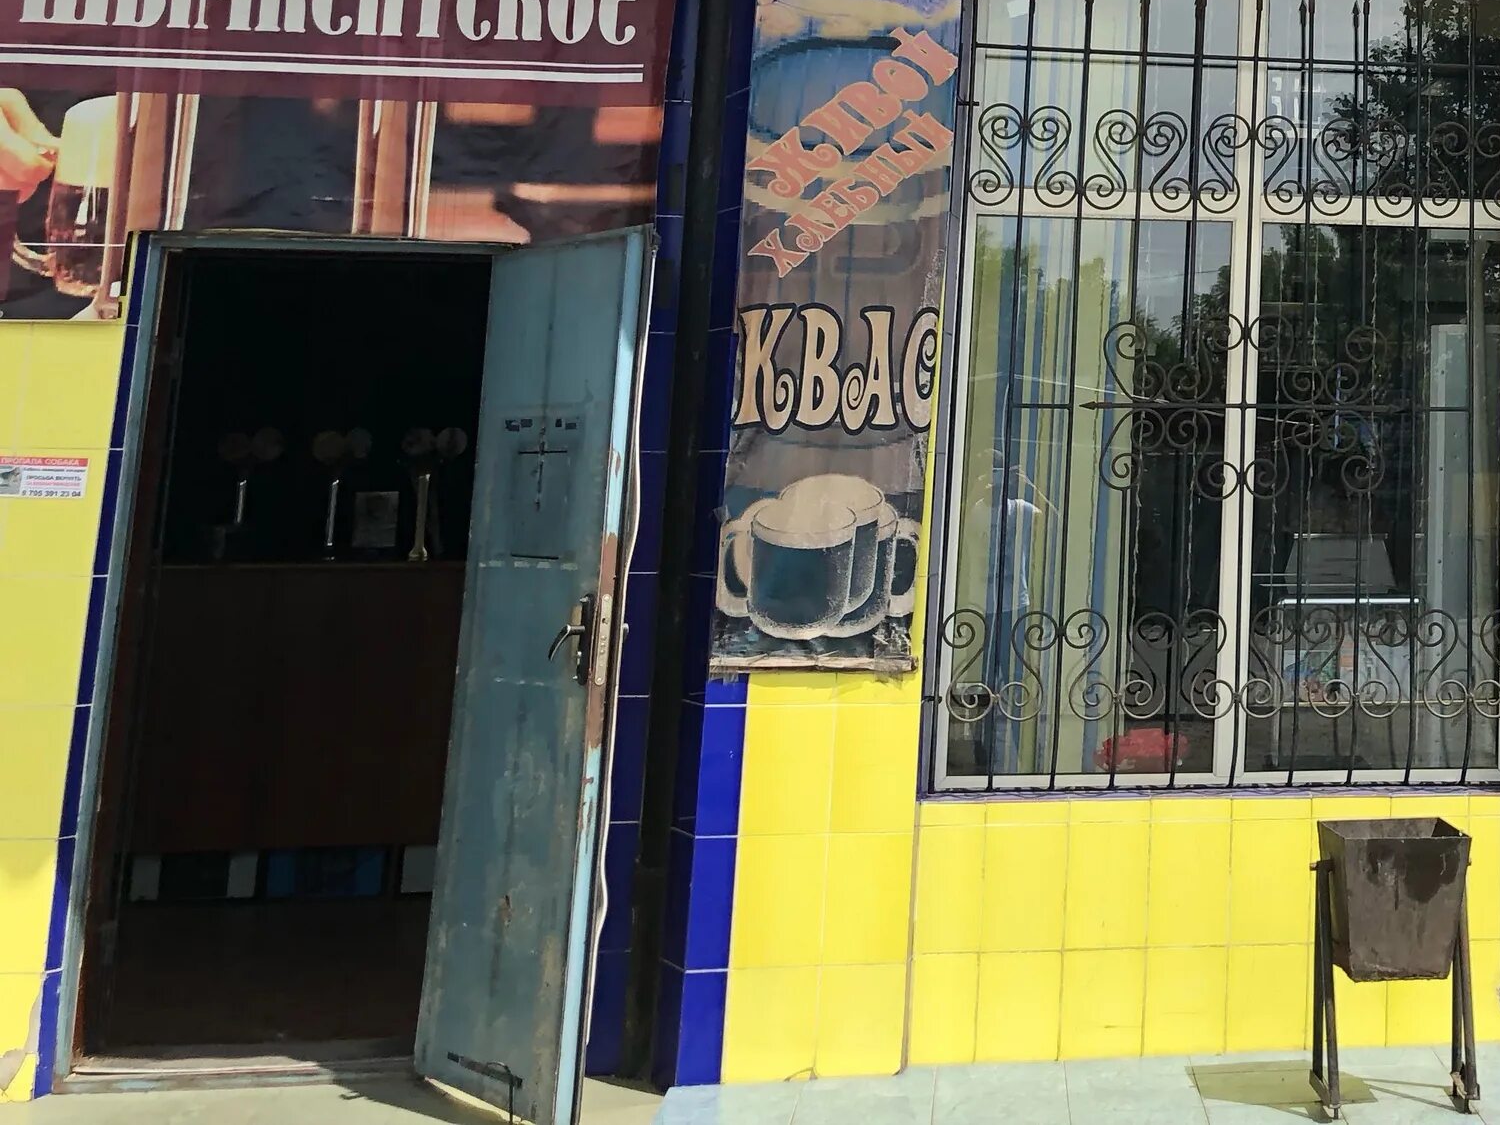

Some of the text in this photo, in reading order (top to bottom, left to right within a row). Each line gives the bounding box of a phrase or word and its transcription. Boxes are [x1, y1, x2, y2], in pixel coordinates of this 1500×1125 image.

[745, 27, 958, 198] ЖИВОЙ
[748, 109, 954, 277] ХЛЕБНЫЙ
[732, 302, 940, 435] КВАС
